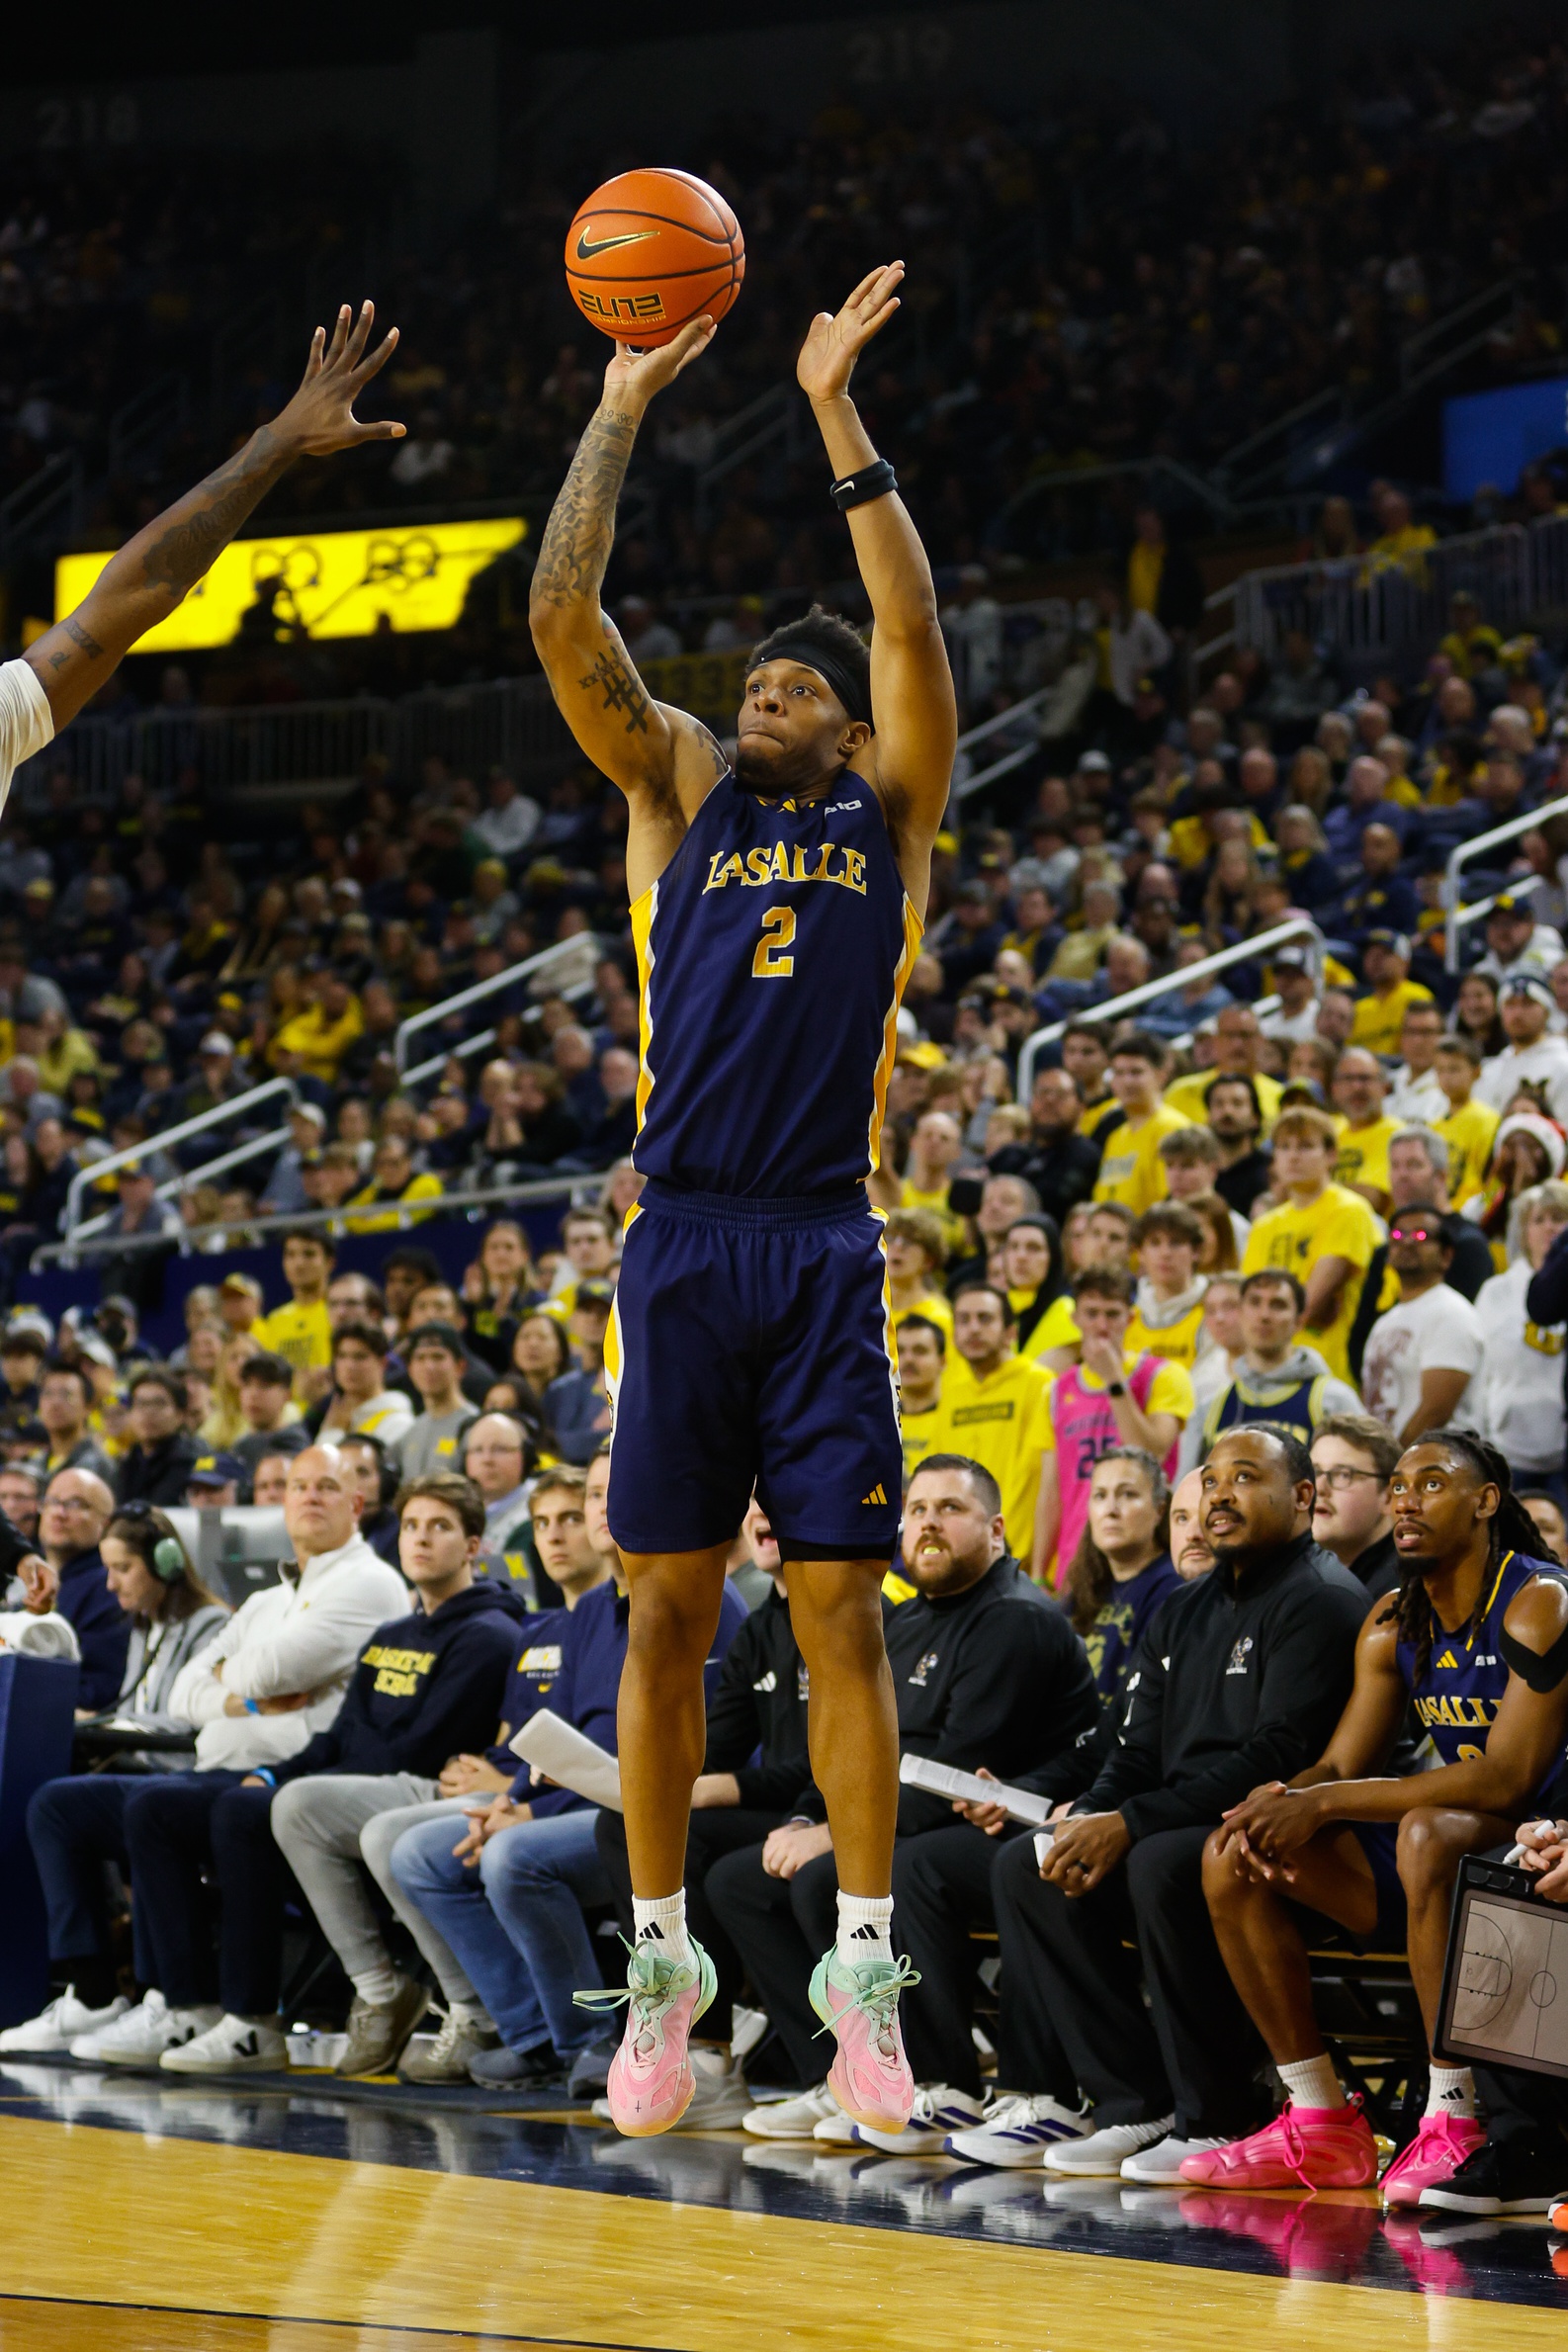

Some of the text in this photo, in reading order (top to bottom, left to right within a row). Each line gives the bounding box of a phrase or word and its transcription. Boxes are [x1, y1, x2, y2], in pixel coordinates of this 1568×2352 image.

[846, 26, 952, 82] 219
[36, 97, 138, 148] 218
[578, 289, 665, 318] ELITE
[594, 314, 666, 325] AMPIONSHIP
[702, 840, 867, 896] LASALLE
[751, 906, 797, 978] 2
